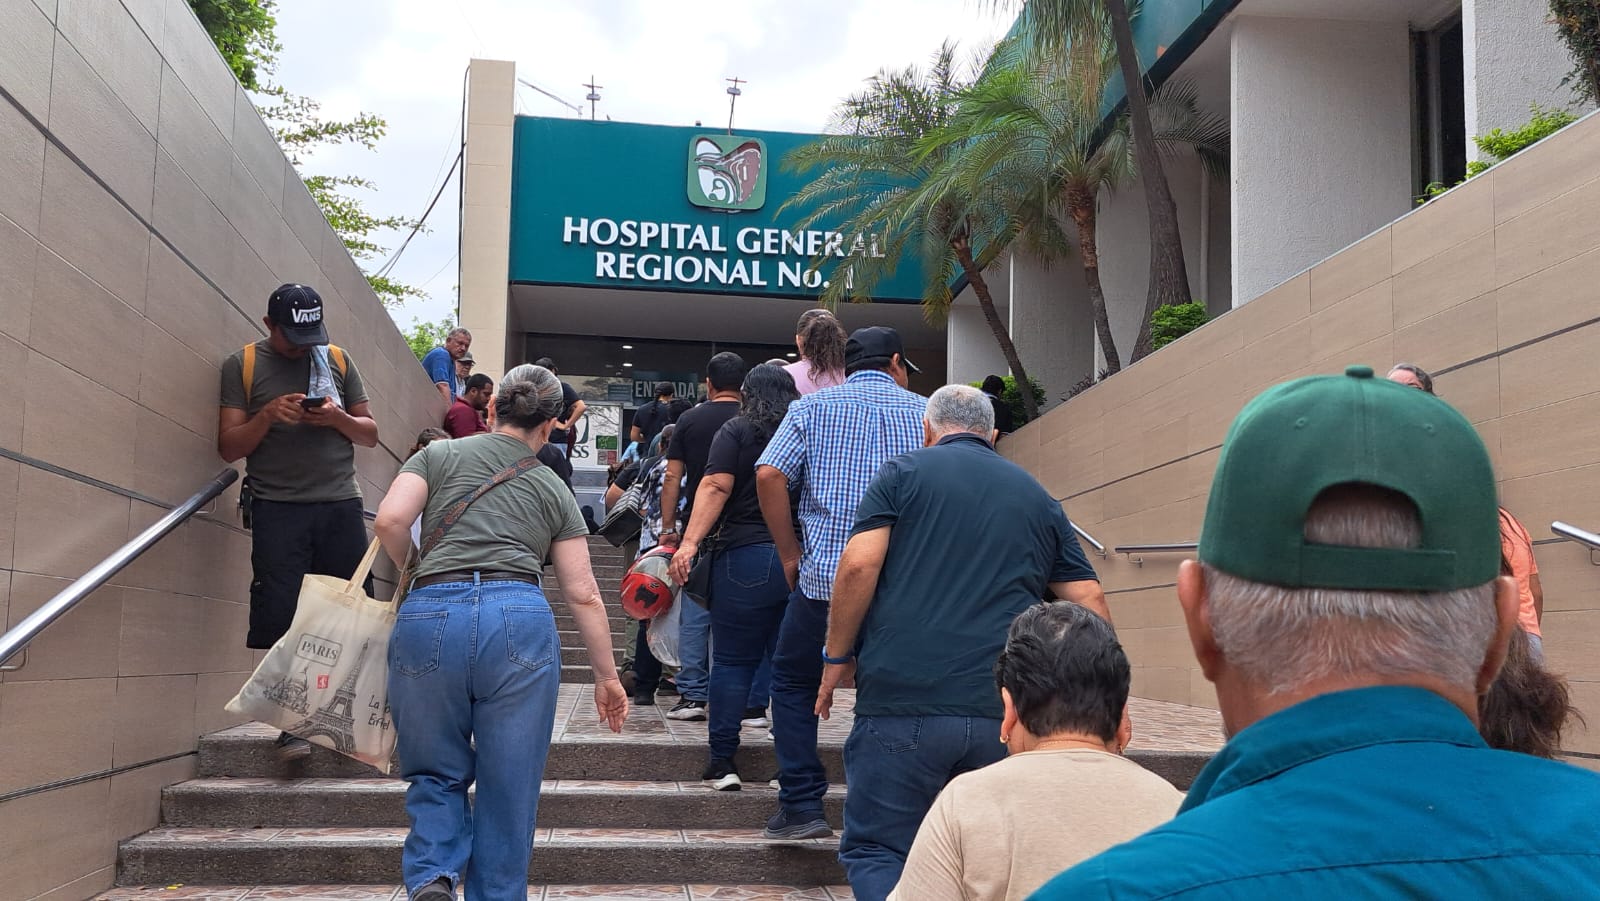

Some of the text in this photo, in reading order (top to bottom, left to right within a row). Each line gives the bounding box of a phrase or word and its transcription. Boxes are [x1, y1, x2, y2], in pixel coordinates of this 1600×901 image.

[563, 216, 886, 258] HOSPITAL GENERAL
[595, 251, 767, 286] REGIONAL
[777, 260, 830, 288] No.
[291, 306, 321, 323] VANS
[635, 381, 695, 399] ENTADA
[571, 445, 589, 458] SS
[301, 641, 339, 661] PARIS
[368, 695, 380, 710] La
[368, 713, 391, 731] Eiffel
